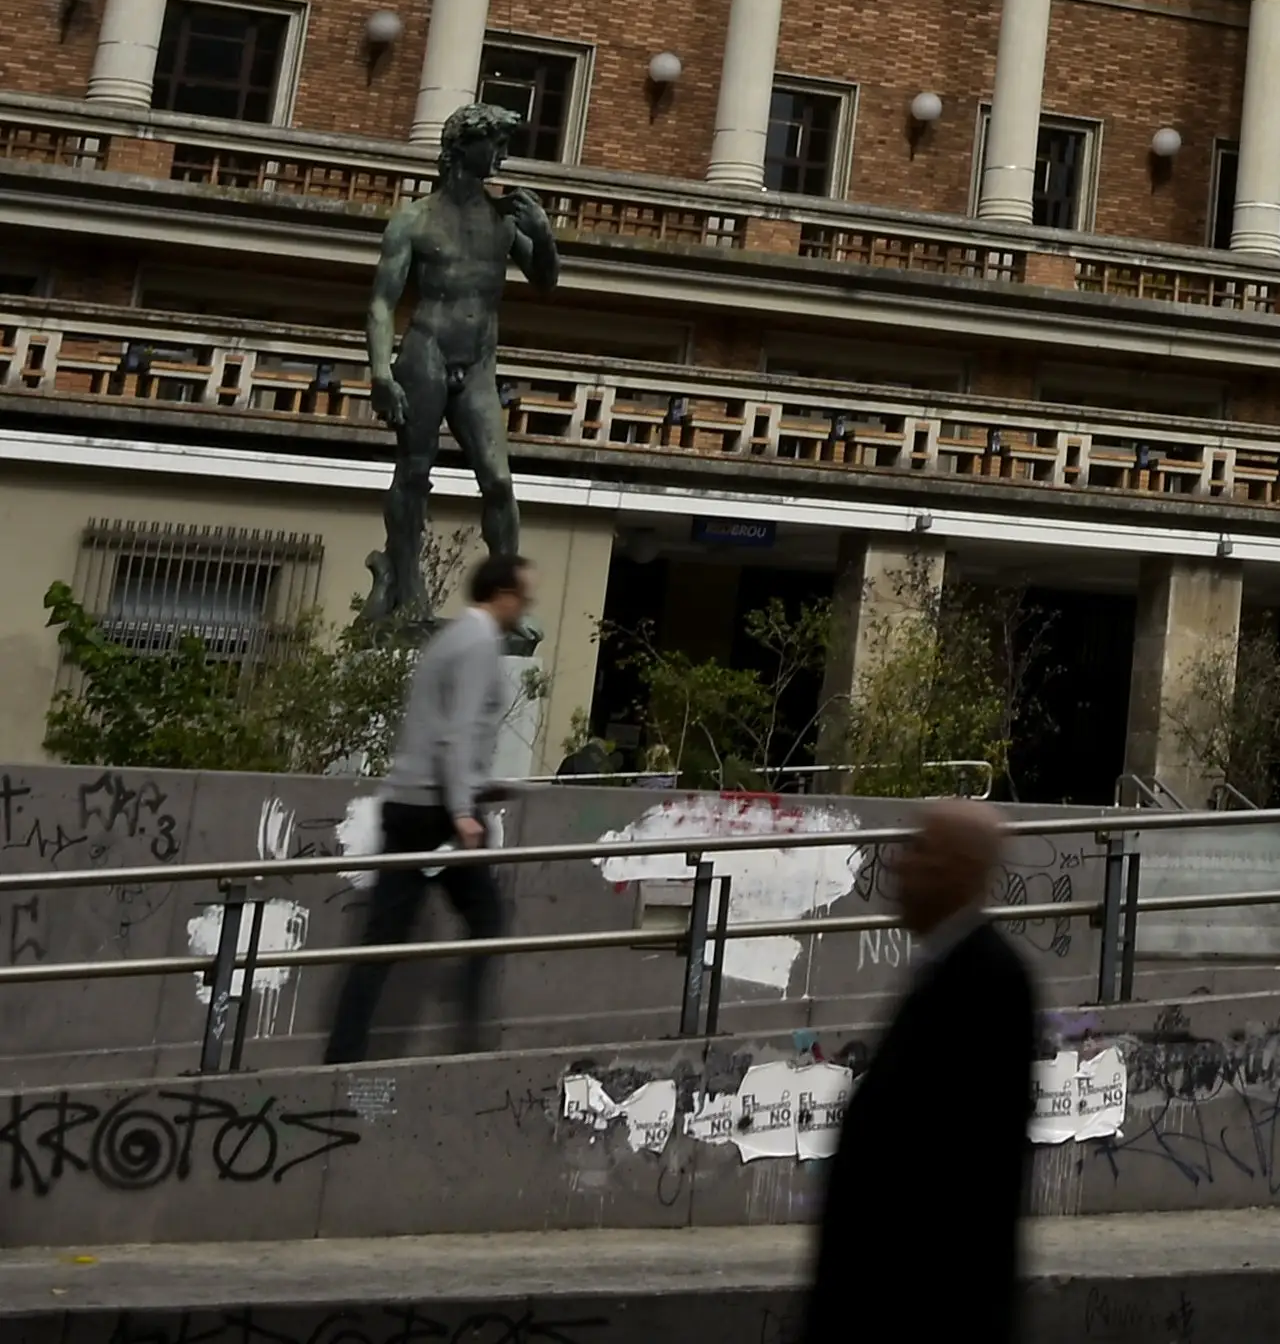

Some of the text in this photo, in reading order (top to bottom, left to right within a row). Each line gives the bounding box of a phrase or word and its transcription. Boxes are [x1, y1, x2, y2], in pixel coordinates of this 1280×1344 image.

[1103, 1089, 1123, 1103] NO
[1052, 1098, 1071, 1110] NO
[769, 1109, 791, 1123] NO
[710, 1119, 732, 1134] NO
[645, 1129, 667, 1143] NO
